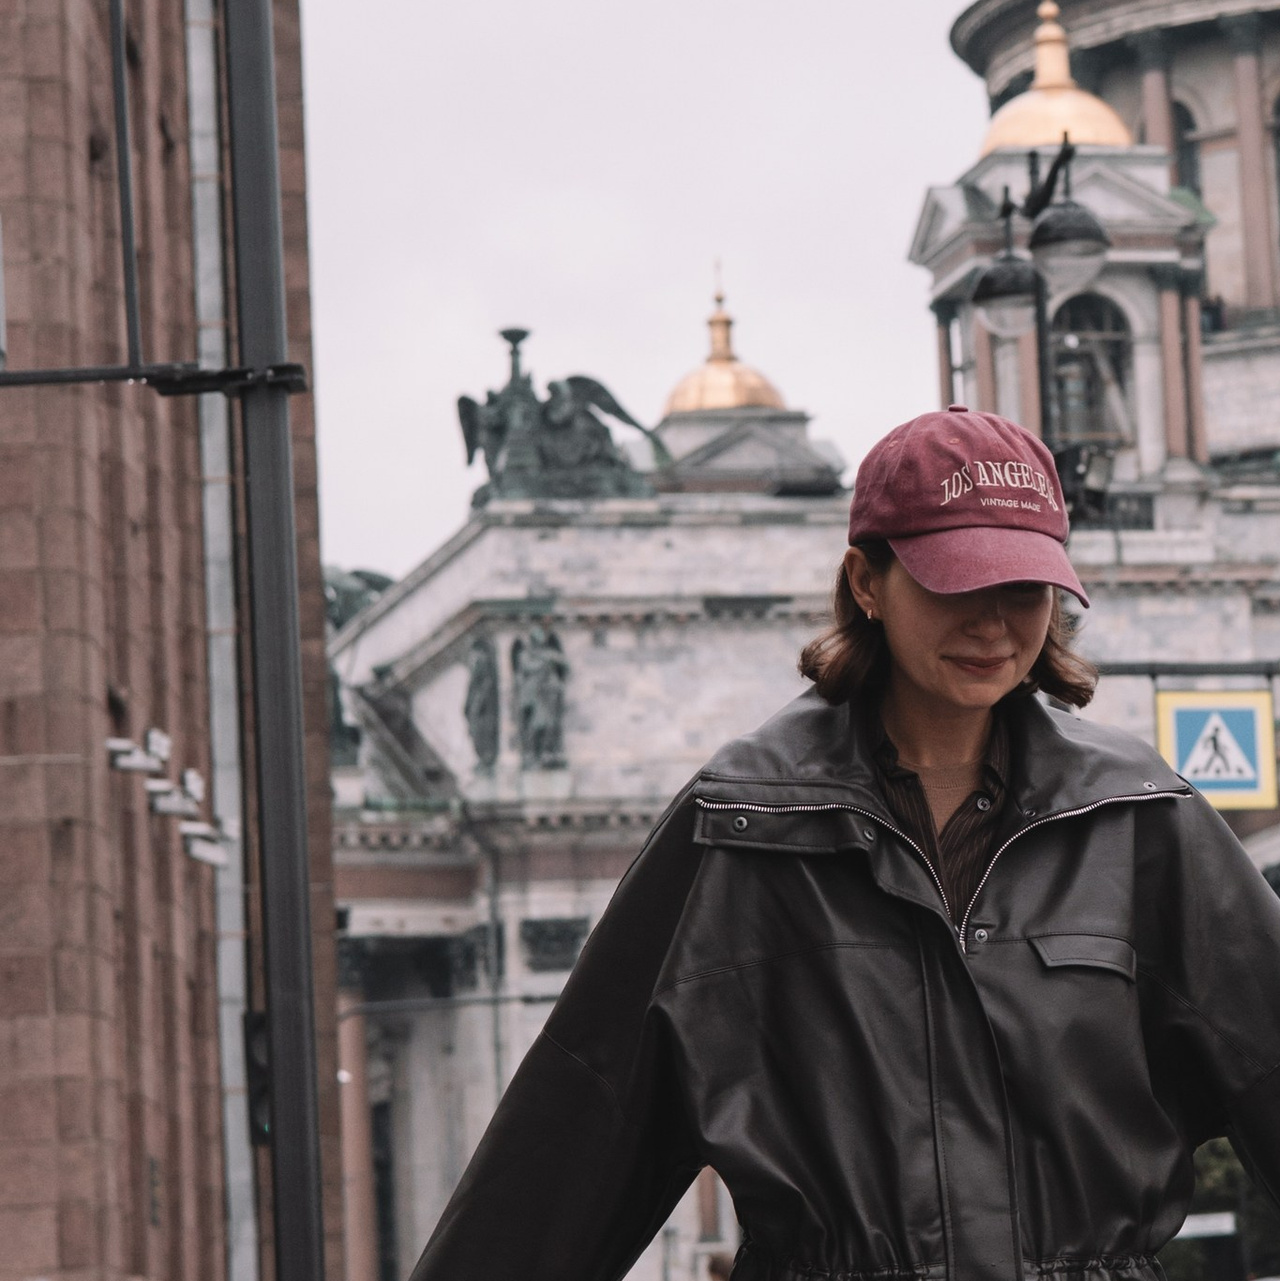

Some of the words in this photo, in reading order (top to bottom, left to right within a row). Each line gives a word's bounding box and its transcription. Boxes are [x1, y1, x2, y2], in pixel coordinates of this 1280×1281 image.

[940, 462, 973, 506] LOS
[974, 461, 1059, 511] ANGELES
[980, 498, 1019, 508] VINTAGE
[1021, 501, 1041, 512] MADE
